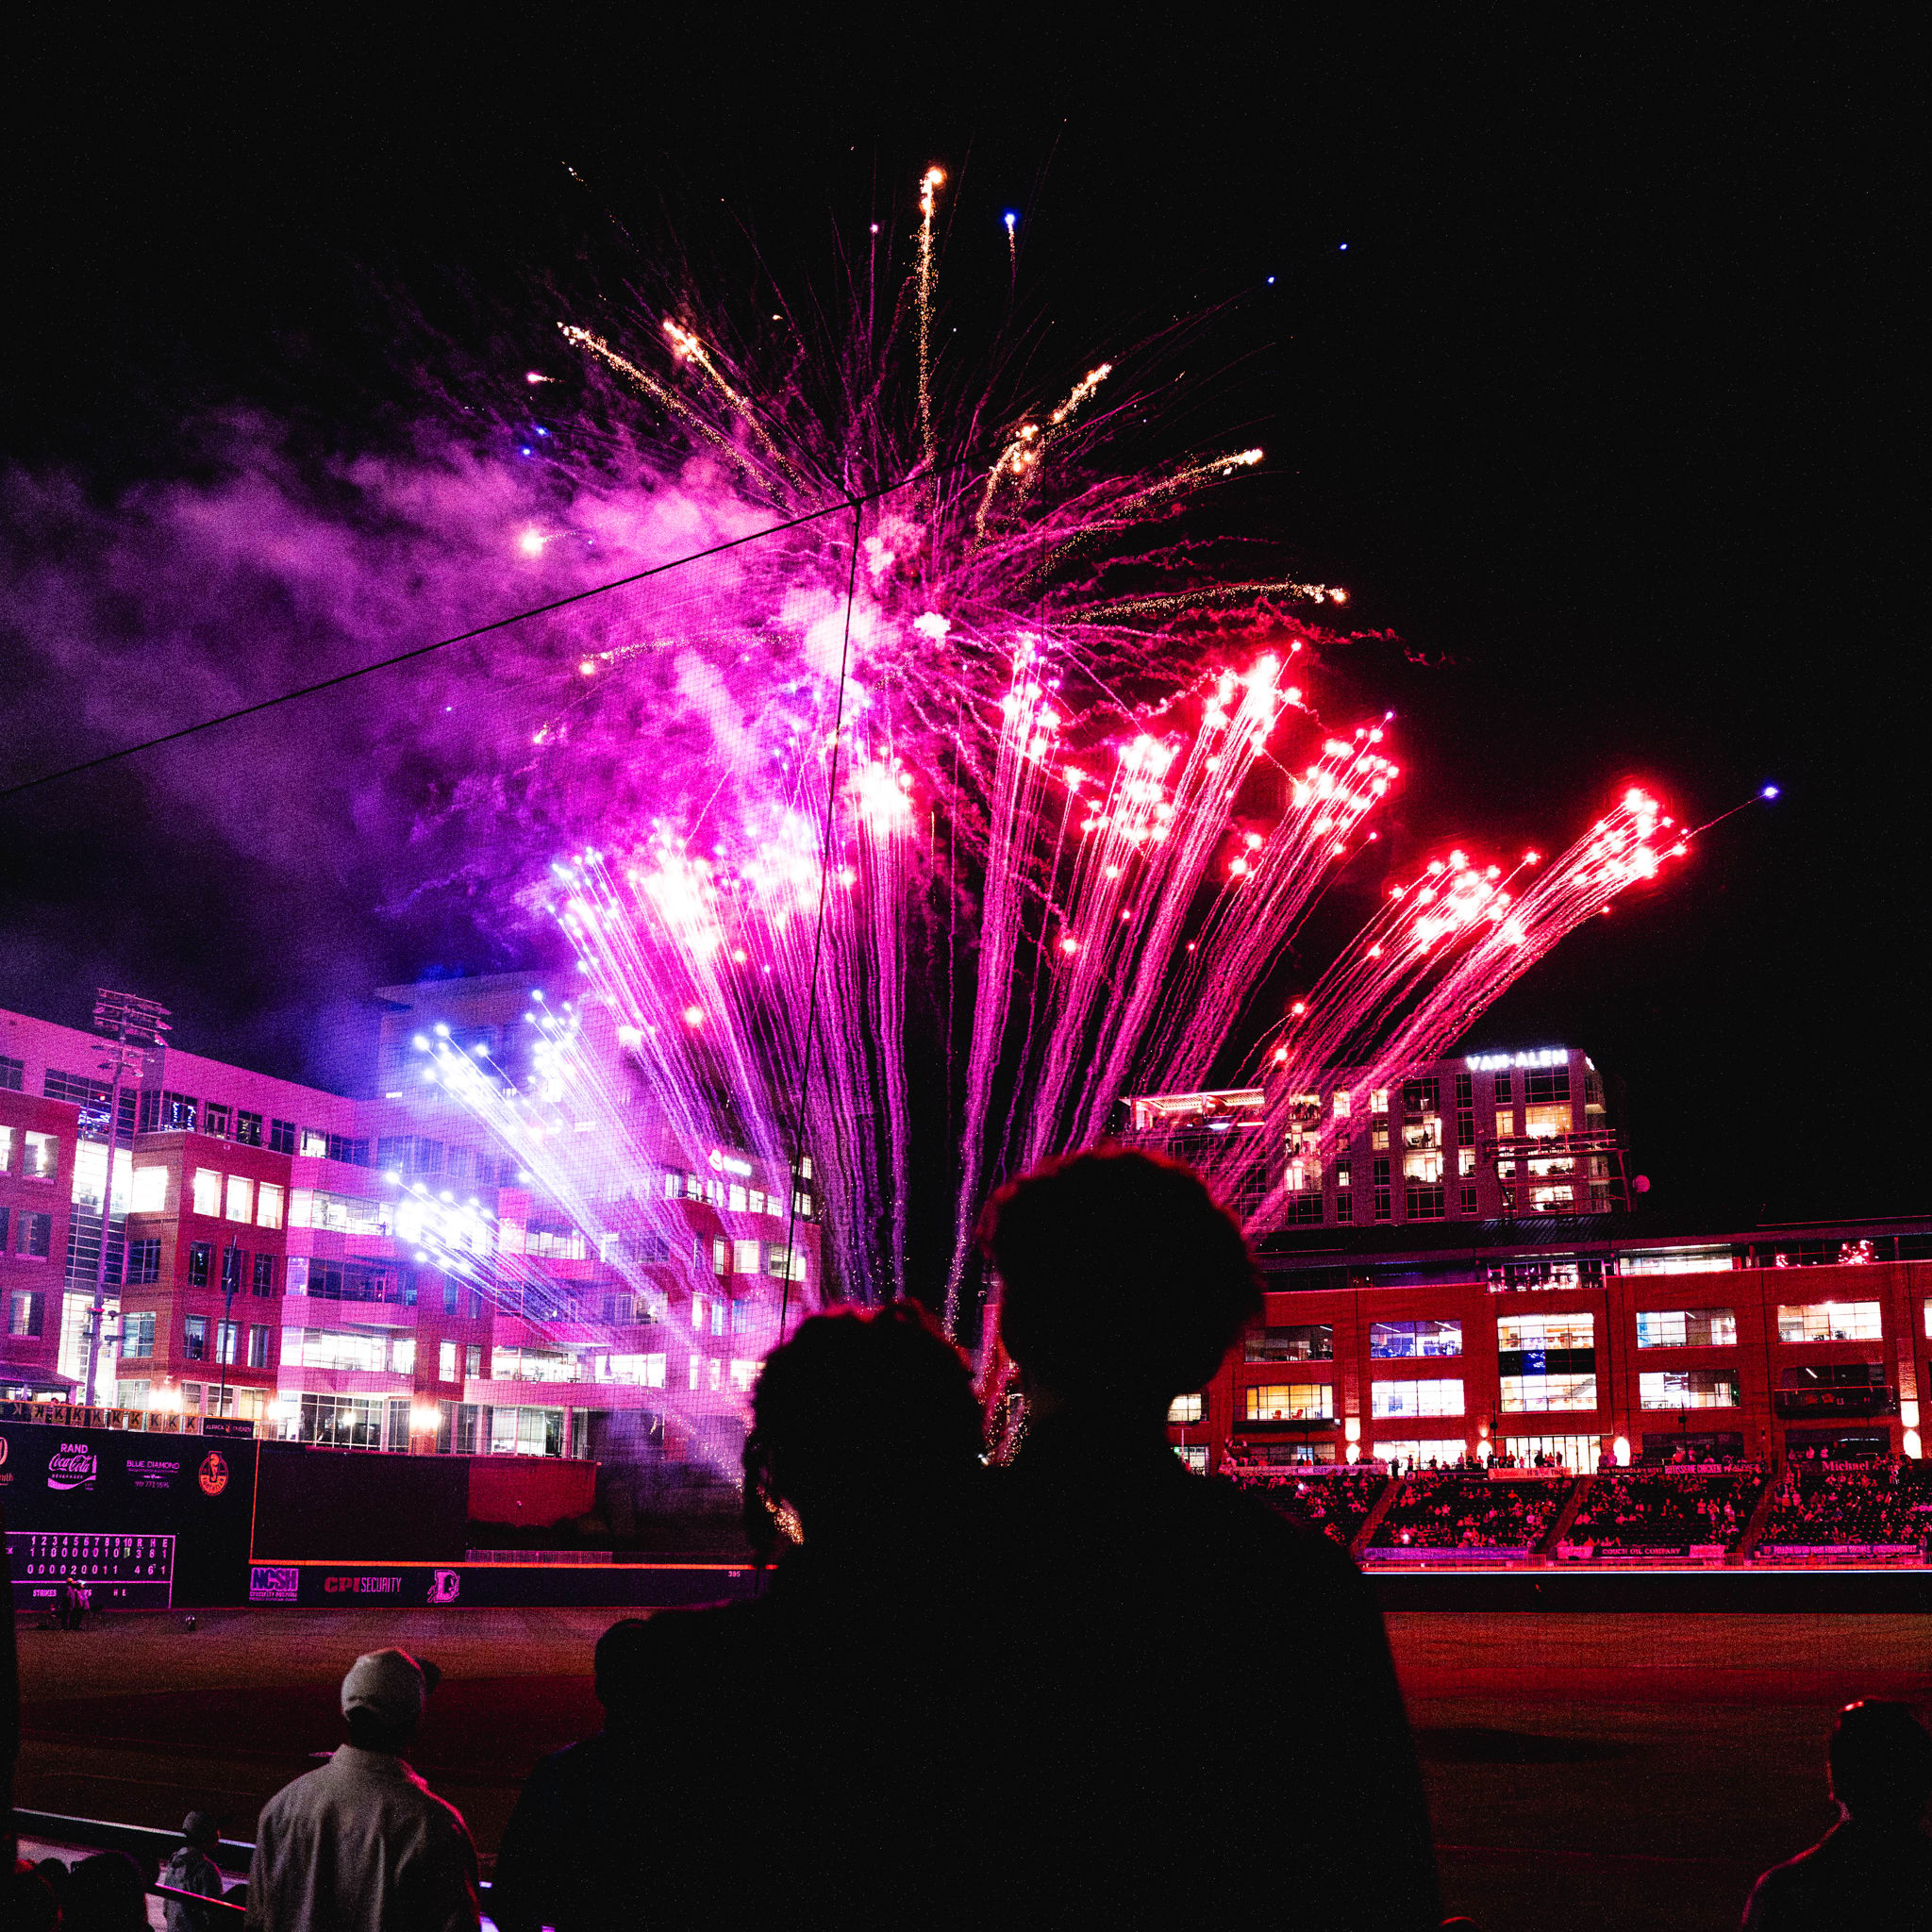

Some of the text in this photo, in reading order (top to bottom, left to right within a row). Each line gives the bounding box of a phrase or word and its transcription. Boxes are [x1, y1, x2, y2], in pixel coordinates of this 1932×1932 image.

[60, 1443, 89, 1454] RAND
[126, 1459, 180, 1470] BLUE DIAMOND
[1822, 1460, 1870, 1472] Michael
[1602, 1547, 1628, 1556] COUCH
[1644, 1547, 1681, 1556] COMPANY
[250, 1567, 299, 1591] NCSH
[325, 1576, 403, 1593] CPI SECURITY
[32, 1589, 58, 1597] STRIKES
